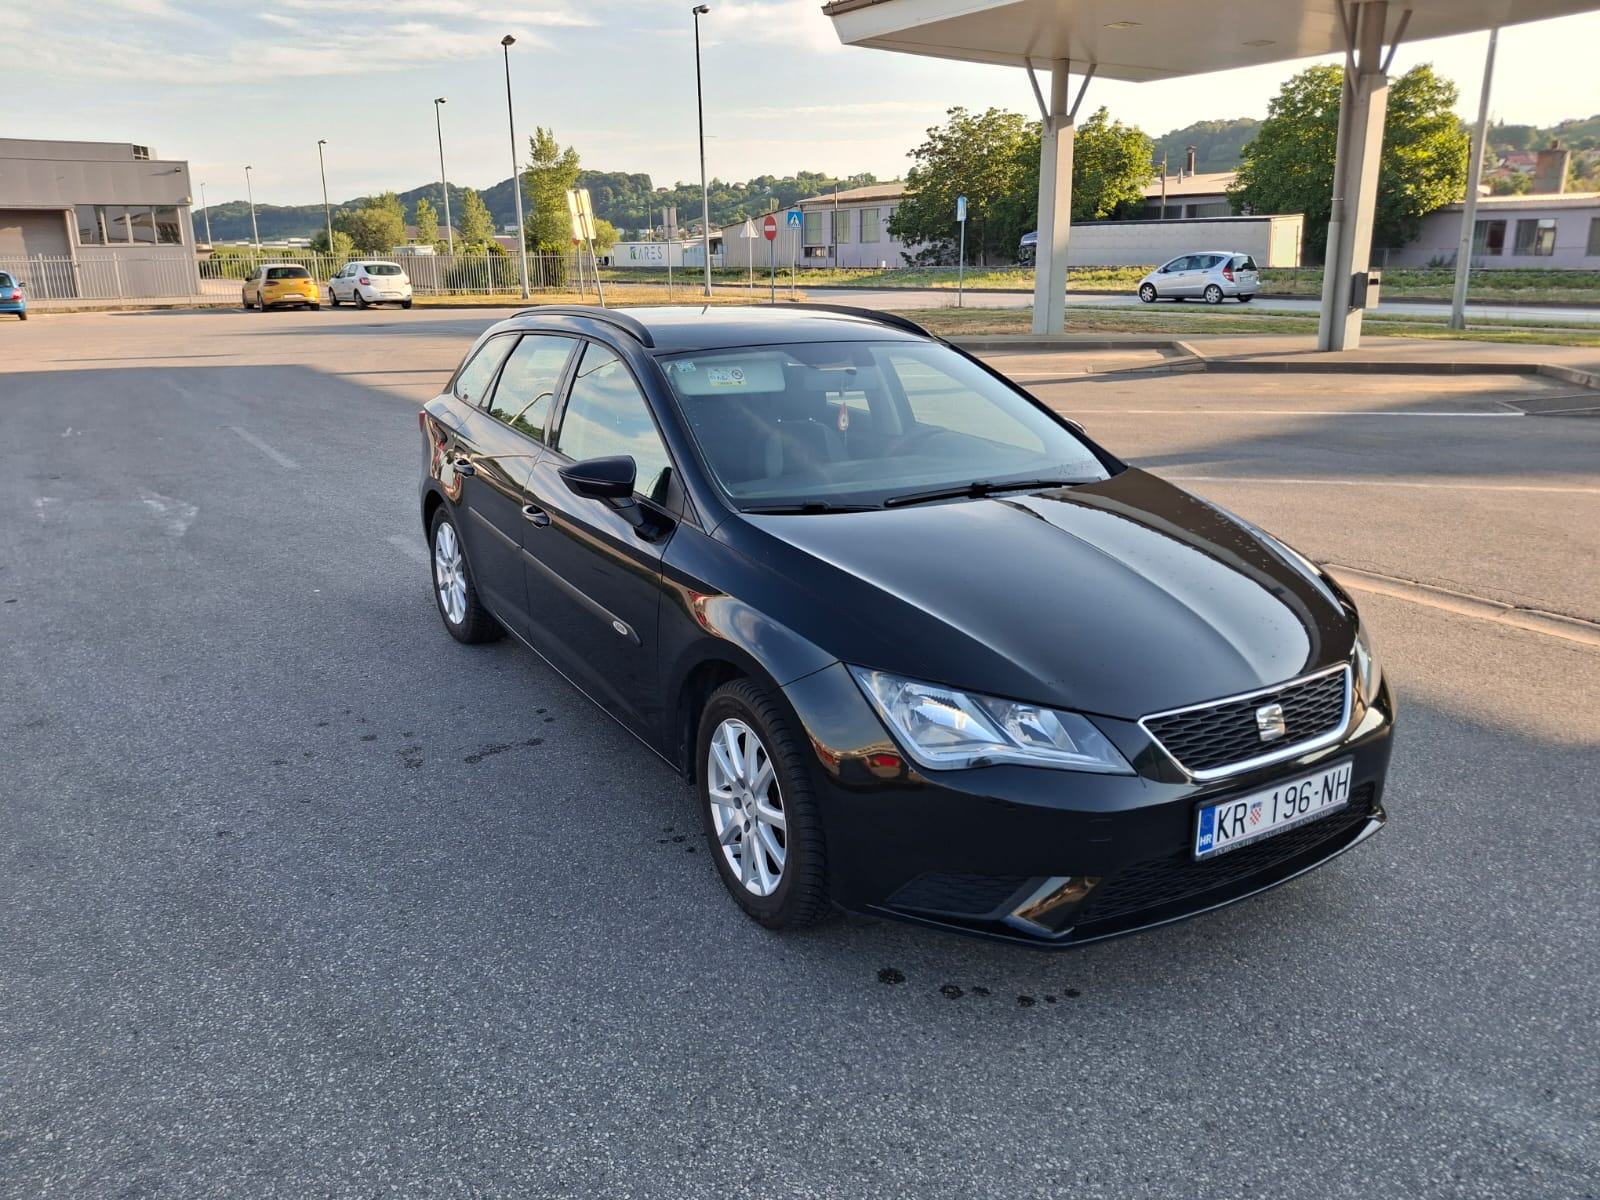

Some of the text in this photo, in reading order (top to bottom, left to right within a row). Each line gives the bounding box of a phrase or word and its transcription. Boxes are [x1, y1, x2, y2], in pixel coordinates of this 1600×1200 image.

[1216, 767, 1350, 843] KR 196-NH
[1200, 833, 1213, 847] HR
